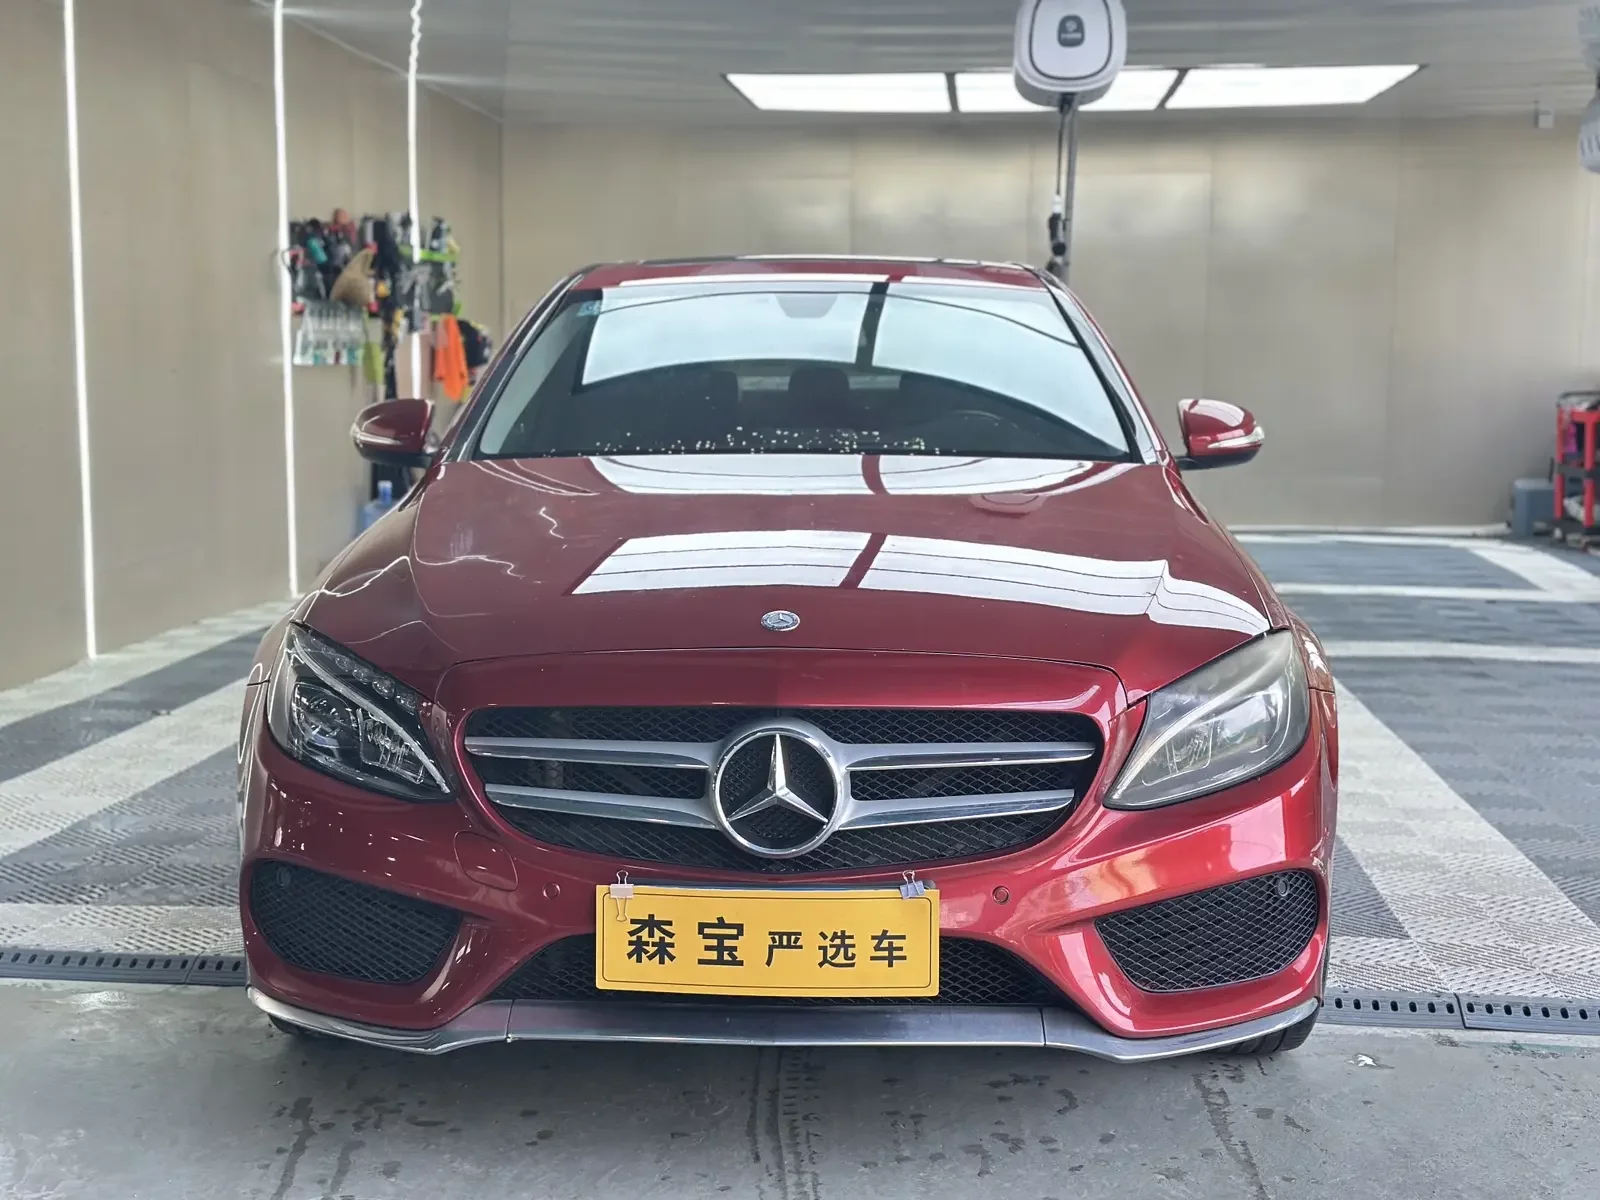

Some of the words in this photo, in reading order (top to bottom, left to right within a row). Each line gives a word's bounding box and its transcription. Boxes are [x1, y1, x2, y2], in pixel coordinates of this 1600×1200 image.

[626, 913, 907, 968] 森宝严选车
